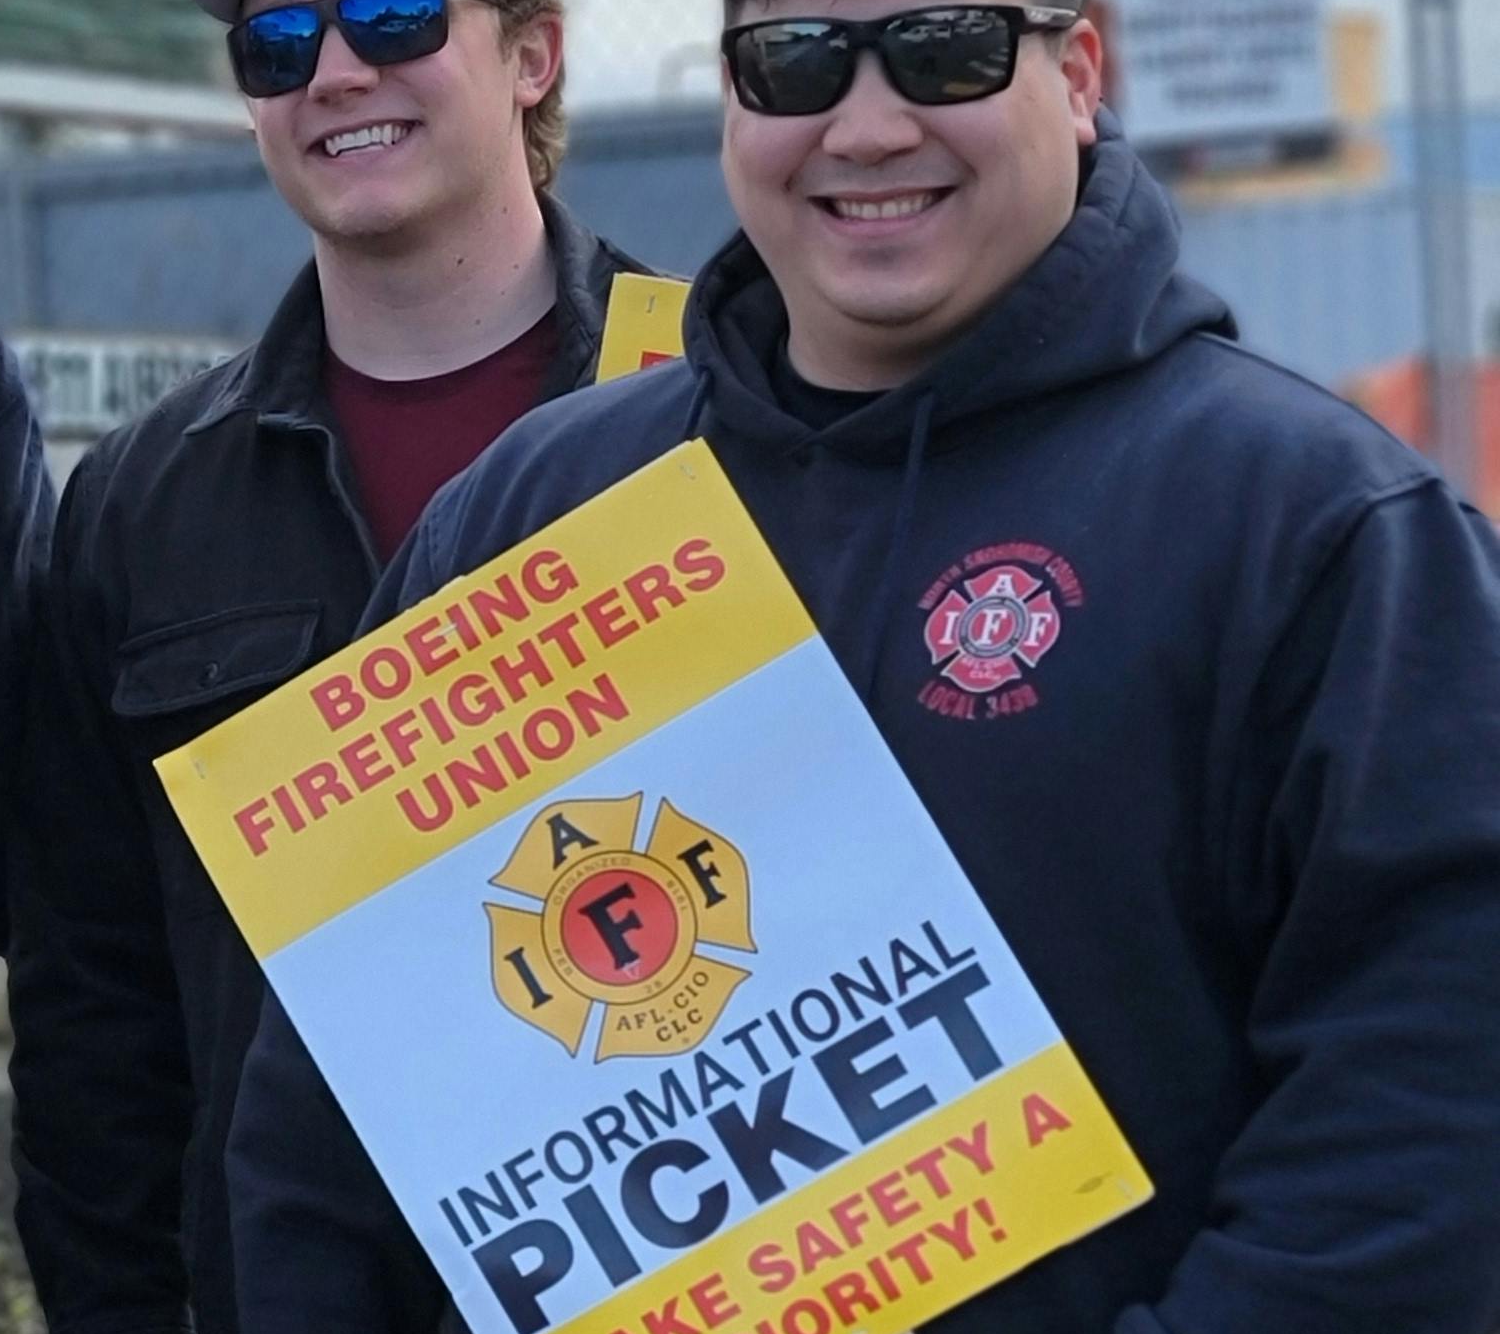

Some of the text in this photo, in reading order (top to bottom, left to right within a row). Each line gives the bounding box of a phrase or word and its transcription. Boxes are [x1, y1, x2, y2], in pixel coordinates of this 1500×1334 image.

[231, 537, 729, 858] FIREFIGHTERS
[309, 548, 581, 733] BOEING
[918, 679, 977, 720] LOCAL
[975, 609, 1008, 646] F
[1024, 612, 1053, 647] F
[395, 672, 632, 835] UNION
[545, 811, 600, 871] A
[552, 856, 632, 907] ORGANIZED
[503, 838, 728, 1010] I F F
[438, 919, 977, 1248] INFORMATIONAL
[656, 1007, 704, 1043] CLC
[745, 1121, 999, 1298] SAFETY
[1018, 1091, 1074, 1147] A
